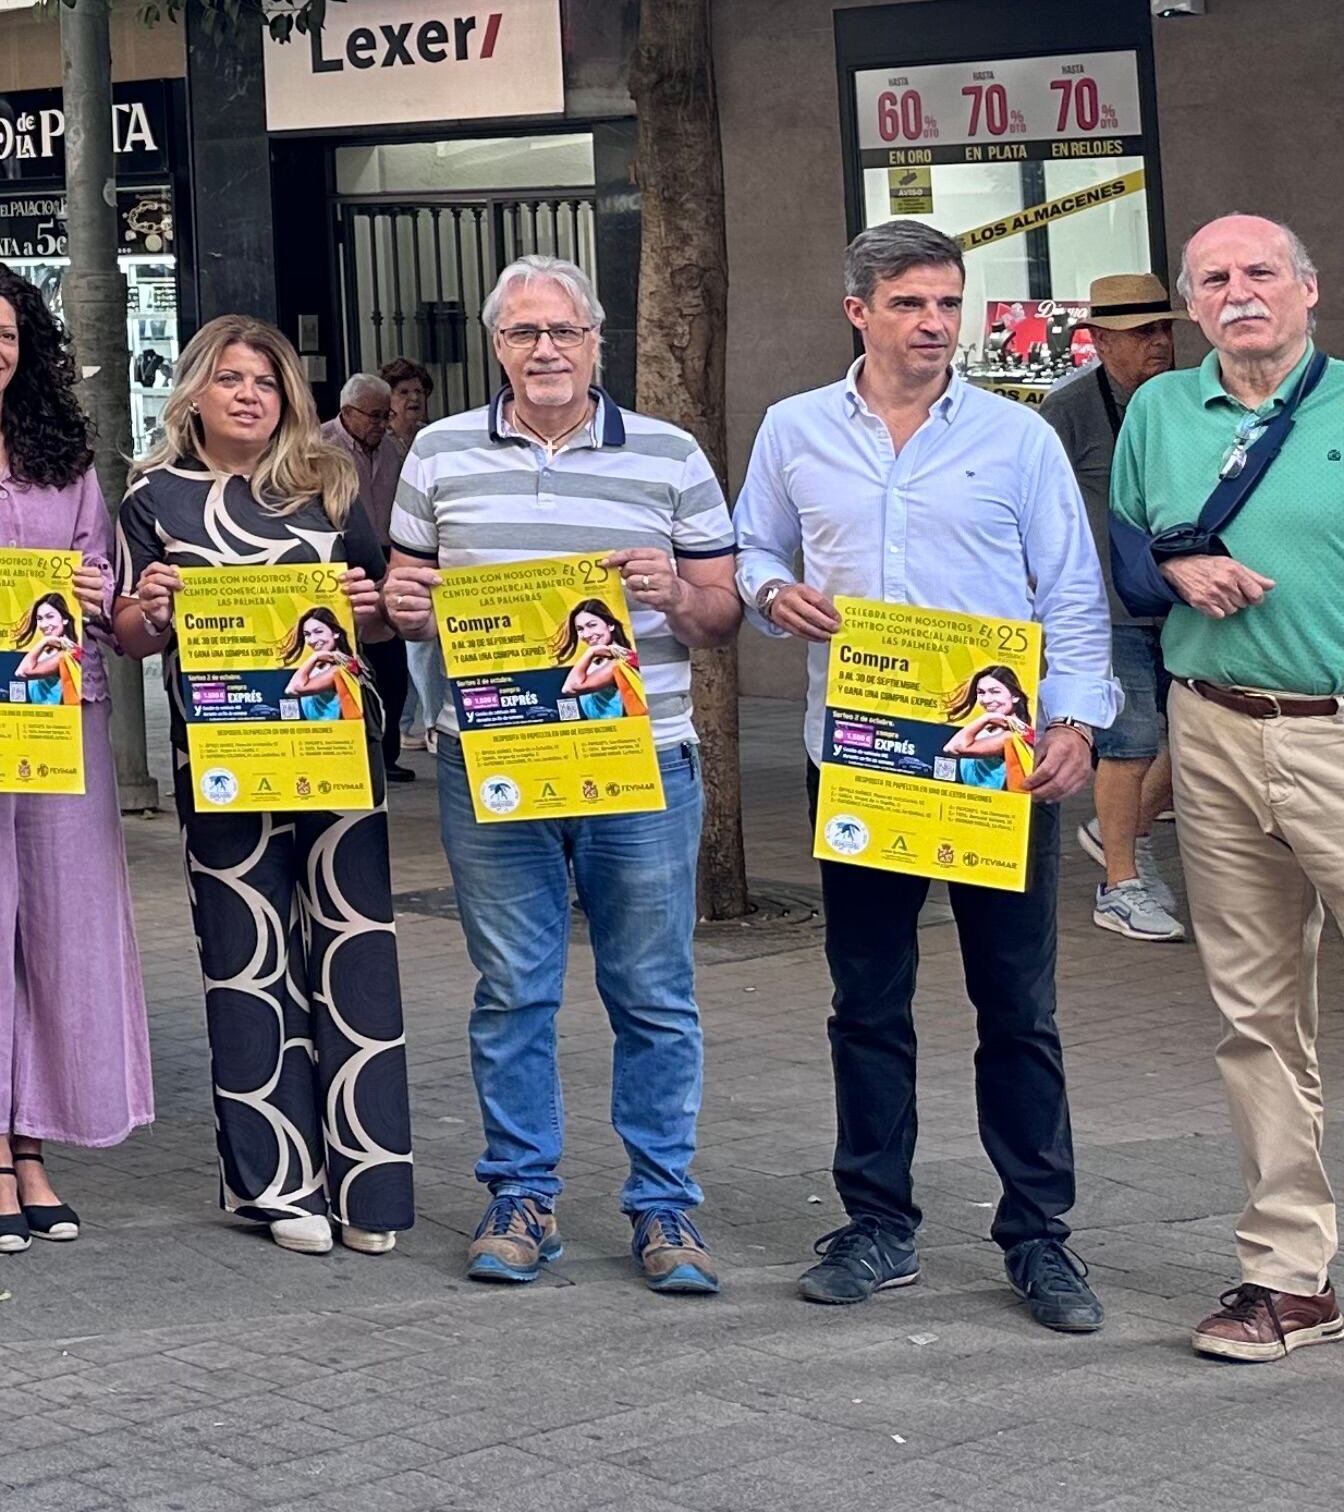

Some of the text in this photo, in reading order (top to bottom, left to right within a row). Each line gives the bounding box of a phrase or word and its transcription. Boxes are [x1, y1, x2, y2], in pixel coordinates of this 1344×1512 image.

[973, 71, 994, 81] HASTA
[1062, 64, 1084, 74] HASTA
[888, 77, 908, 86] HASTA
[16, 112, 36, 132] de
[40, 102, 158, 158] PTA
[1009, 123, 1026, 133] DTO
[1101, 119, 1118, 129] DTO
[923, 129, 939, 138] DTO
[16, 134, 36, 158] LA
[966, 145, 1027, 160] EN PLATA
[1053, 141, 1123, 156] EN RELOJES
[890, 149, 931, 164] EN ORO
[971, 181, 1125, 244] LOS ALMACENES
[24, 243, 33, 256] a
[50, 556, 73, 578] 25
[578, 560, 608, 584] 25
[312, 570, 338, 592] 25
[185, 613, 244, 631] Compra
[447, 615, 511, 634] Compra
[997, 625, 1028, 652] 25
[840, 645, 909, 673] Compra
[227, 689, 262, 702] EXPRÉS
[500, 690, 538, 707] EXPRÉS
[873, 735, 917, 755] EXPRÉS
